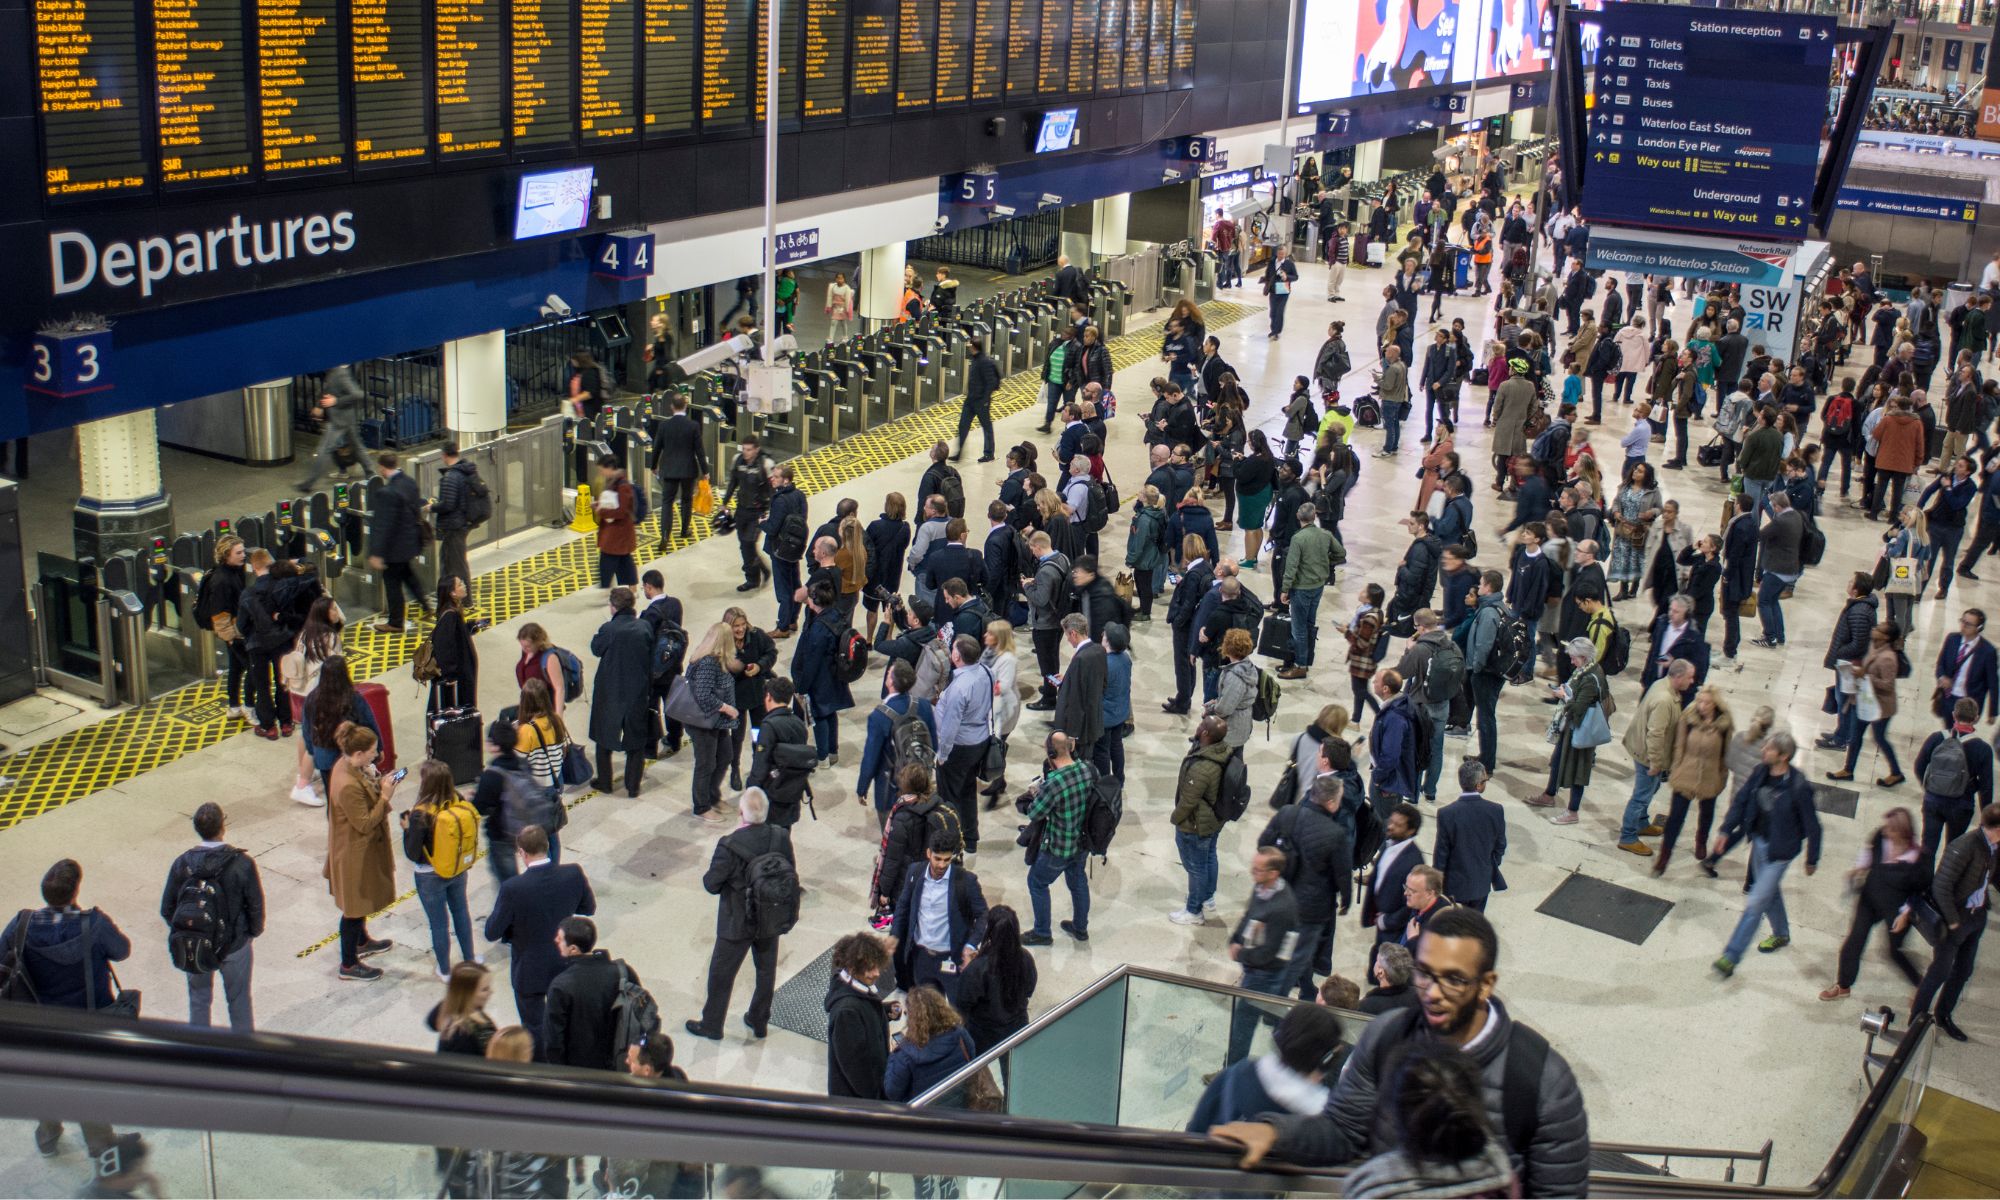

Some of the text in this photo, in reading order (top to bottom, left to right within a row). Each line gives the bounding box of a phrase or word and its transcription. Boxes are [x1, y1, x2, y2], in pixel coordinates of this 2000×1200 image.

[37, 2, 72, 10] Clapham
[154, 0, 185, 8] Clapham
[352, 7, 386, 15] Earlsfield
[156, 21, 198, 29] Twickenham
[260, 18, 302, 26] Southampton
[38, 24, 82, 32] Wimbledon
[260, 28, 302, 36] Southampton
[1690, 22, 1781, 37] Station reception
[38, 36, 69, 44] Raynes
[260, 38, 306, 46] Brockenhurst
[1649, 38, 1682, 50] Toilets
[190, 41, 223, 50] (Surrey)
[275, 48, 298, 56] Milton
[260, 58, 307, 66] Christchurch
[1647, 58, 1683, 70] Tickets
[41, 69, 80, 78] Kingston
[158, 64, 180, 73] Egham
[261, 68, 297, 76] Pokesdown
[41, 78, 97, 88] Hampton Wick
[158, 74, 192, 83] Virginia
[262, 78, 304, 86] Bournemouth
[159, 84, 206, 93] Sunningdale
[1645, 78, 1670, 90] Taxis
[43, 90, 90, 100] Teddington
[262, 88, 282, 96] Poole
[1517, 87, 1525, 97] 9
[52, 101, 100, 110] Strawberry
[262, 98, 298, 106] Hamworthy
[1449, 98, 1457, 110] 8
[1642, 97, 1673, 108] Buses
[160, 106, 190, 114] Martins
[262, 108, 292, 117] Wareham
[160, 115, 198, 124] Bracknell
[263, 118, 280, 126] Wool
[1329, 118, 1338, 131] 7
[161, 126, 200, 135] Wokingham
[1641, 116, 1752, 136] Waterloo East Station
[263, 128, 292, 136] Moreton
[264, 136, 302, 146] Dorchester
[438, 133, 452, 144] SWR
[356, 140, 372, 152] SWR
[1638, 136, 1720, 152] London Eye Pier
[264, 148, 281, 160] SWR
[1189, 142, 1200, 157] 6
[1208, 142, 1214, 158] 6
[163, 158, 182, 171] SWR
[1637, 156, 1680, 168] Way out
[48, 170, 68, 182] SWR
[200, 168, 229, 178] coaches
[62, 181, 104, 192] Customers
[108, 180, 122, 188] for
[962, 179, 974, 200] 5
[986, 180, 994, 200] 5
[1694, 188, 1760, 204] Underground
[1875, 202, 1902, 211] Waterloo
[1916, 206, 1938, 214] Station
[1650, 207, 1674, 215] Waterloo
[1714, 209, 1736, 222] Way
[1738, 214, 1758, 222] out
[1967, 210, 1972, 218] 7
[50, 210, 356, 296] Departures
[1738, 244, 1792, 256] NetworkRail
[603, 244, 619, 270] 4
[634, 243, 648, 268] 4
[1596, 249, 1750, 274] Welcome to Waterloo Station
[1750, 288, 1792, 312] SW
[1767, 312, 1782, 332] R
[33, 345, 50, 382] 3
[77, 345, 100, 382] 3
[184, 700, 221, 718] KEEP
